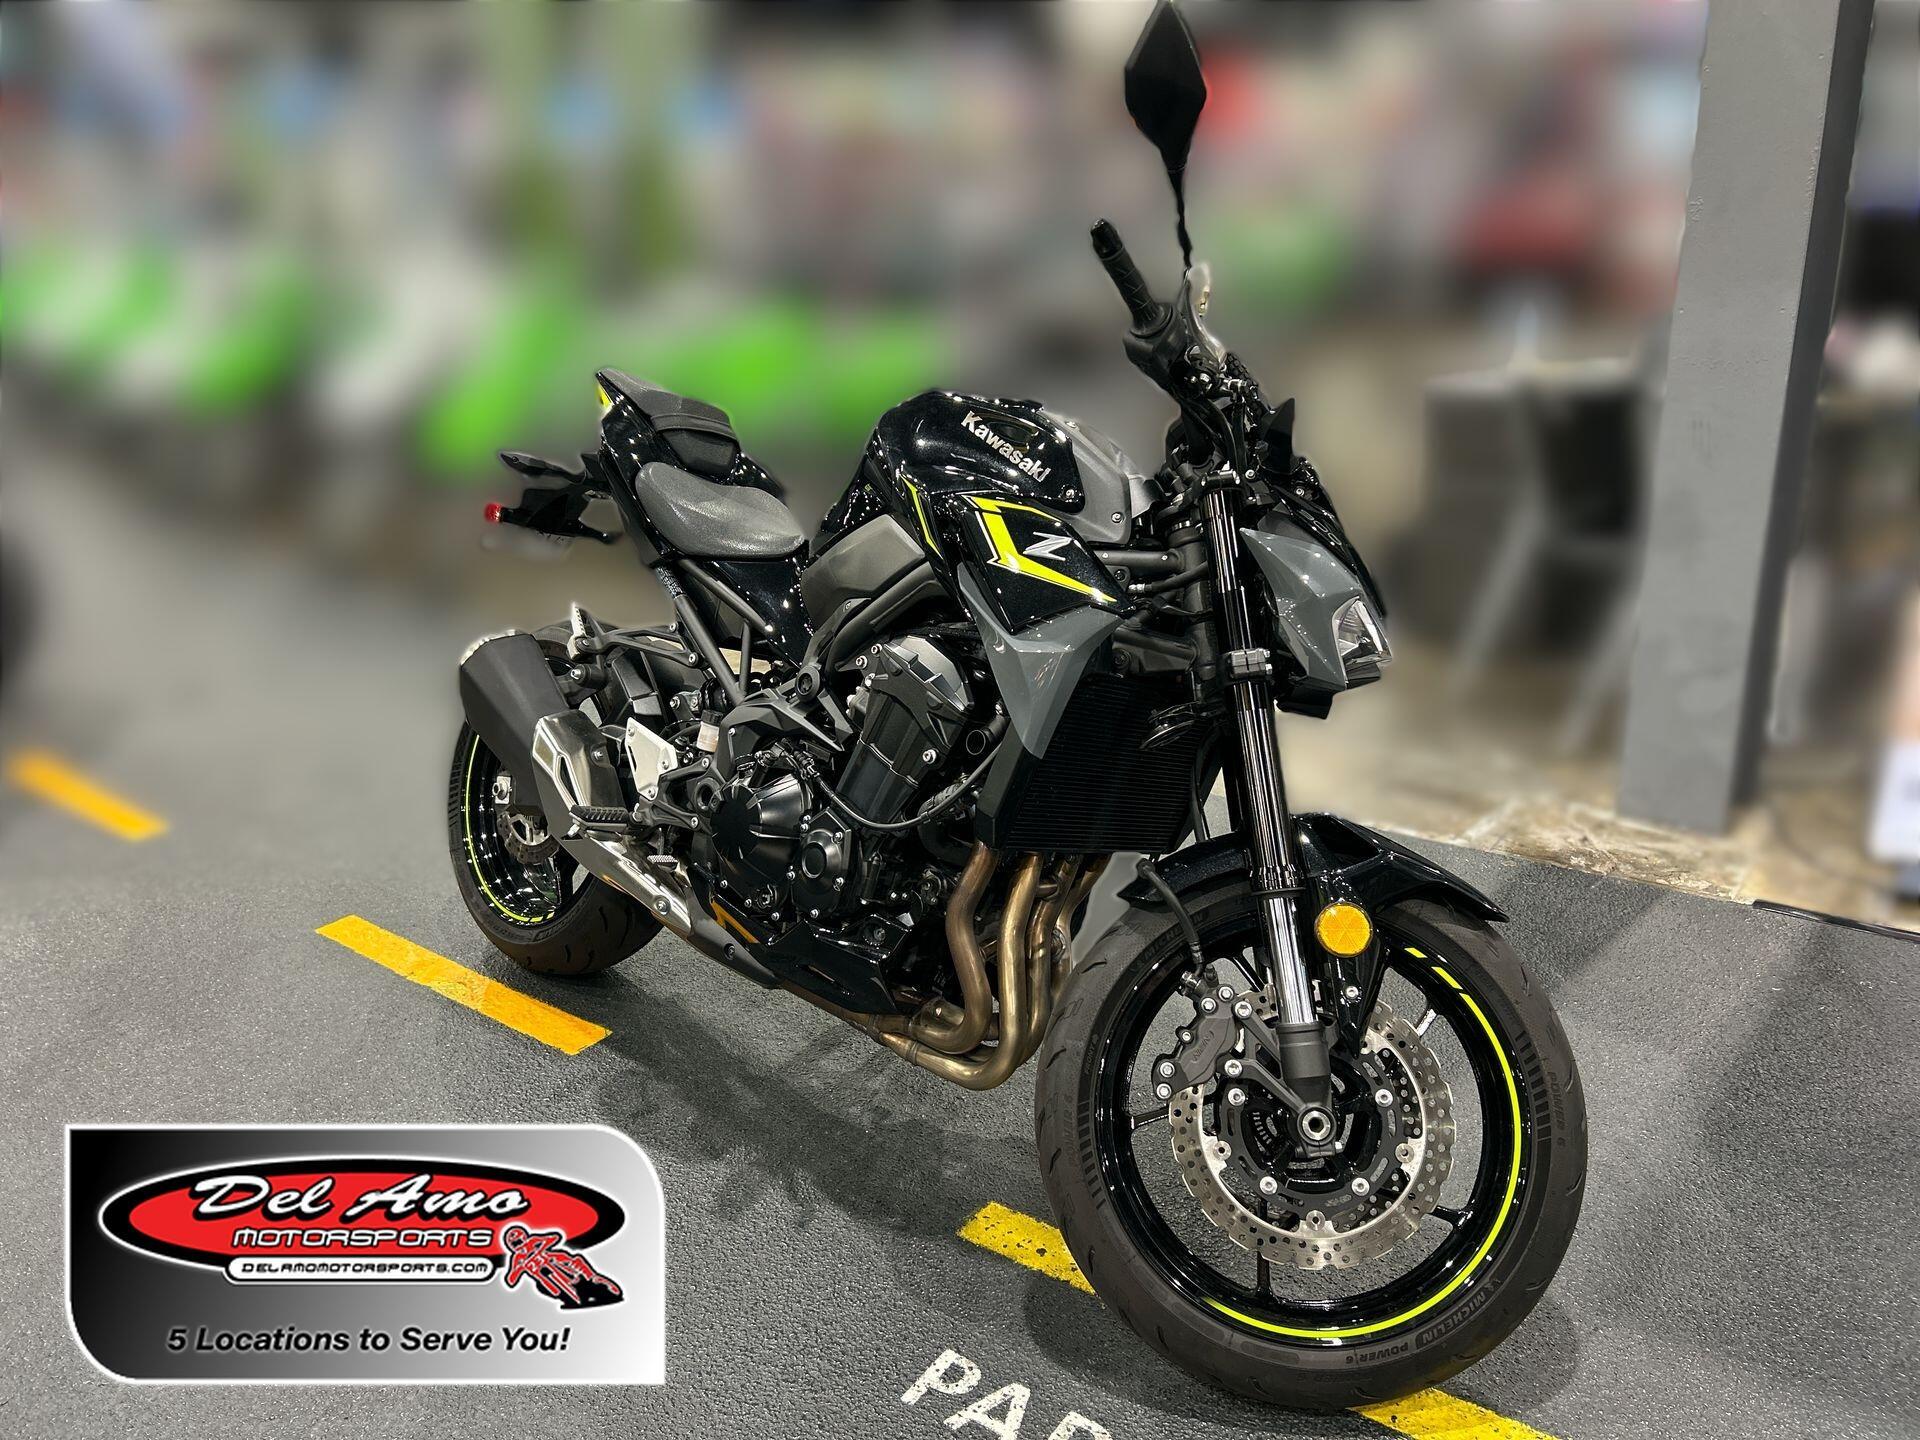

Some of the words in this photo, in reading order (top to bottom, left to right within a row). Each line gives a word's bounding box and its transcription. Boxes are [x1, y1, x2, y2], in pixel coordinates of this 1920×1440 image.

[961, 410, 1051, 482] Kawasaki
[1023, 532, 1072, 561] Z
[1420, 1291, 1486, 1344] MICHELIN
[1358, 1342, 1409, 1364] POWER
